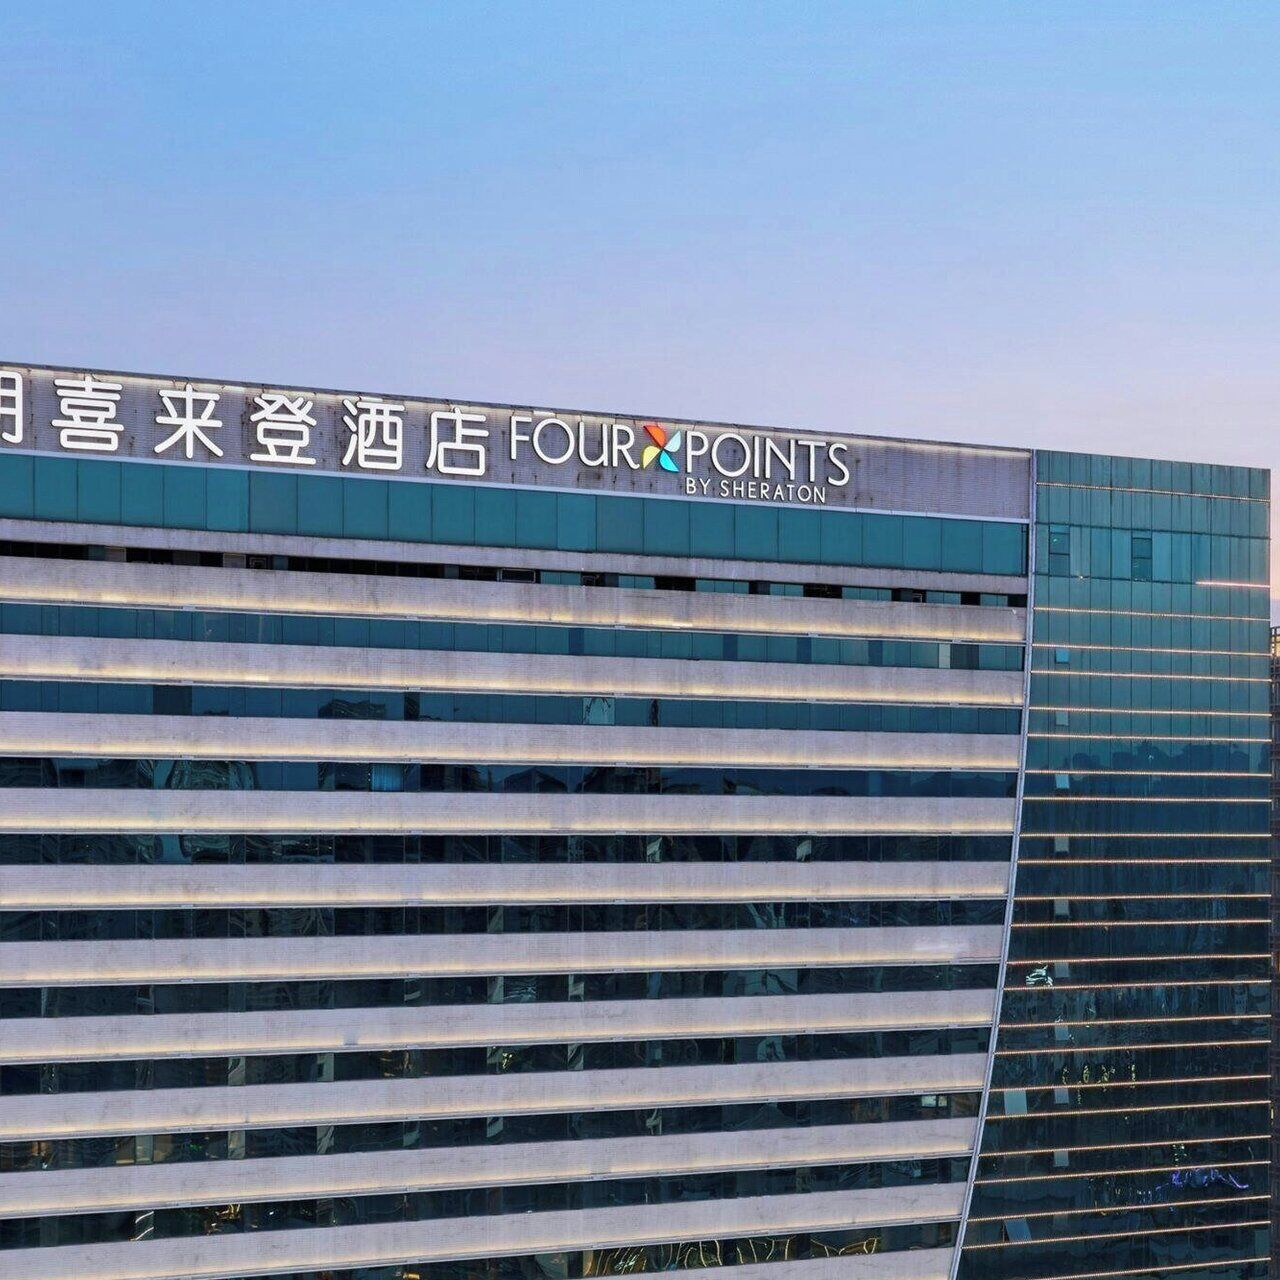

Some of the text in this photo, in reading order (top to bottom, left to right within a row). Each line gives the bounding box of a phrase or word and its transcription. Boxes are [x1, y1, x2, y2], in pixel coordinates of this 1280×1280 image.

[509, 415, 851, 487] FOUR POINTS
[685, 477, 827, 504] BY SHERATON
